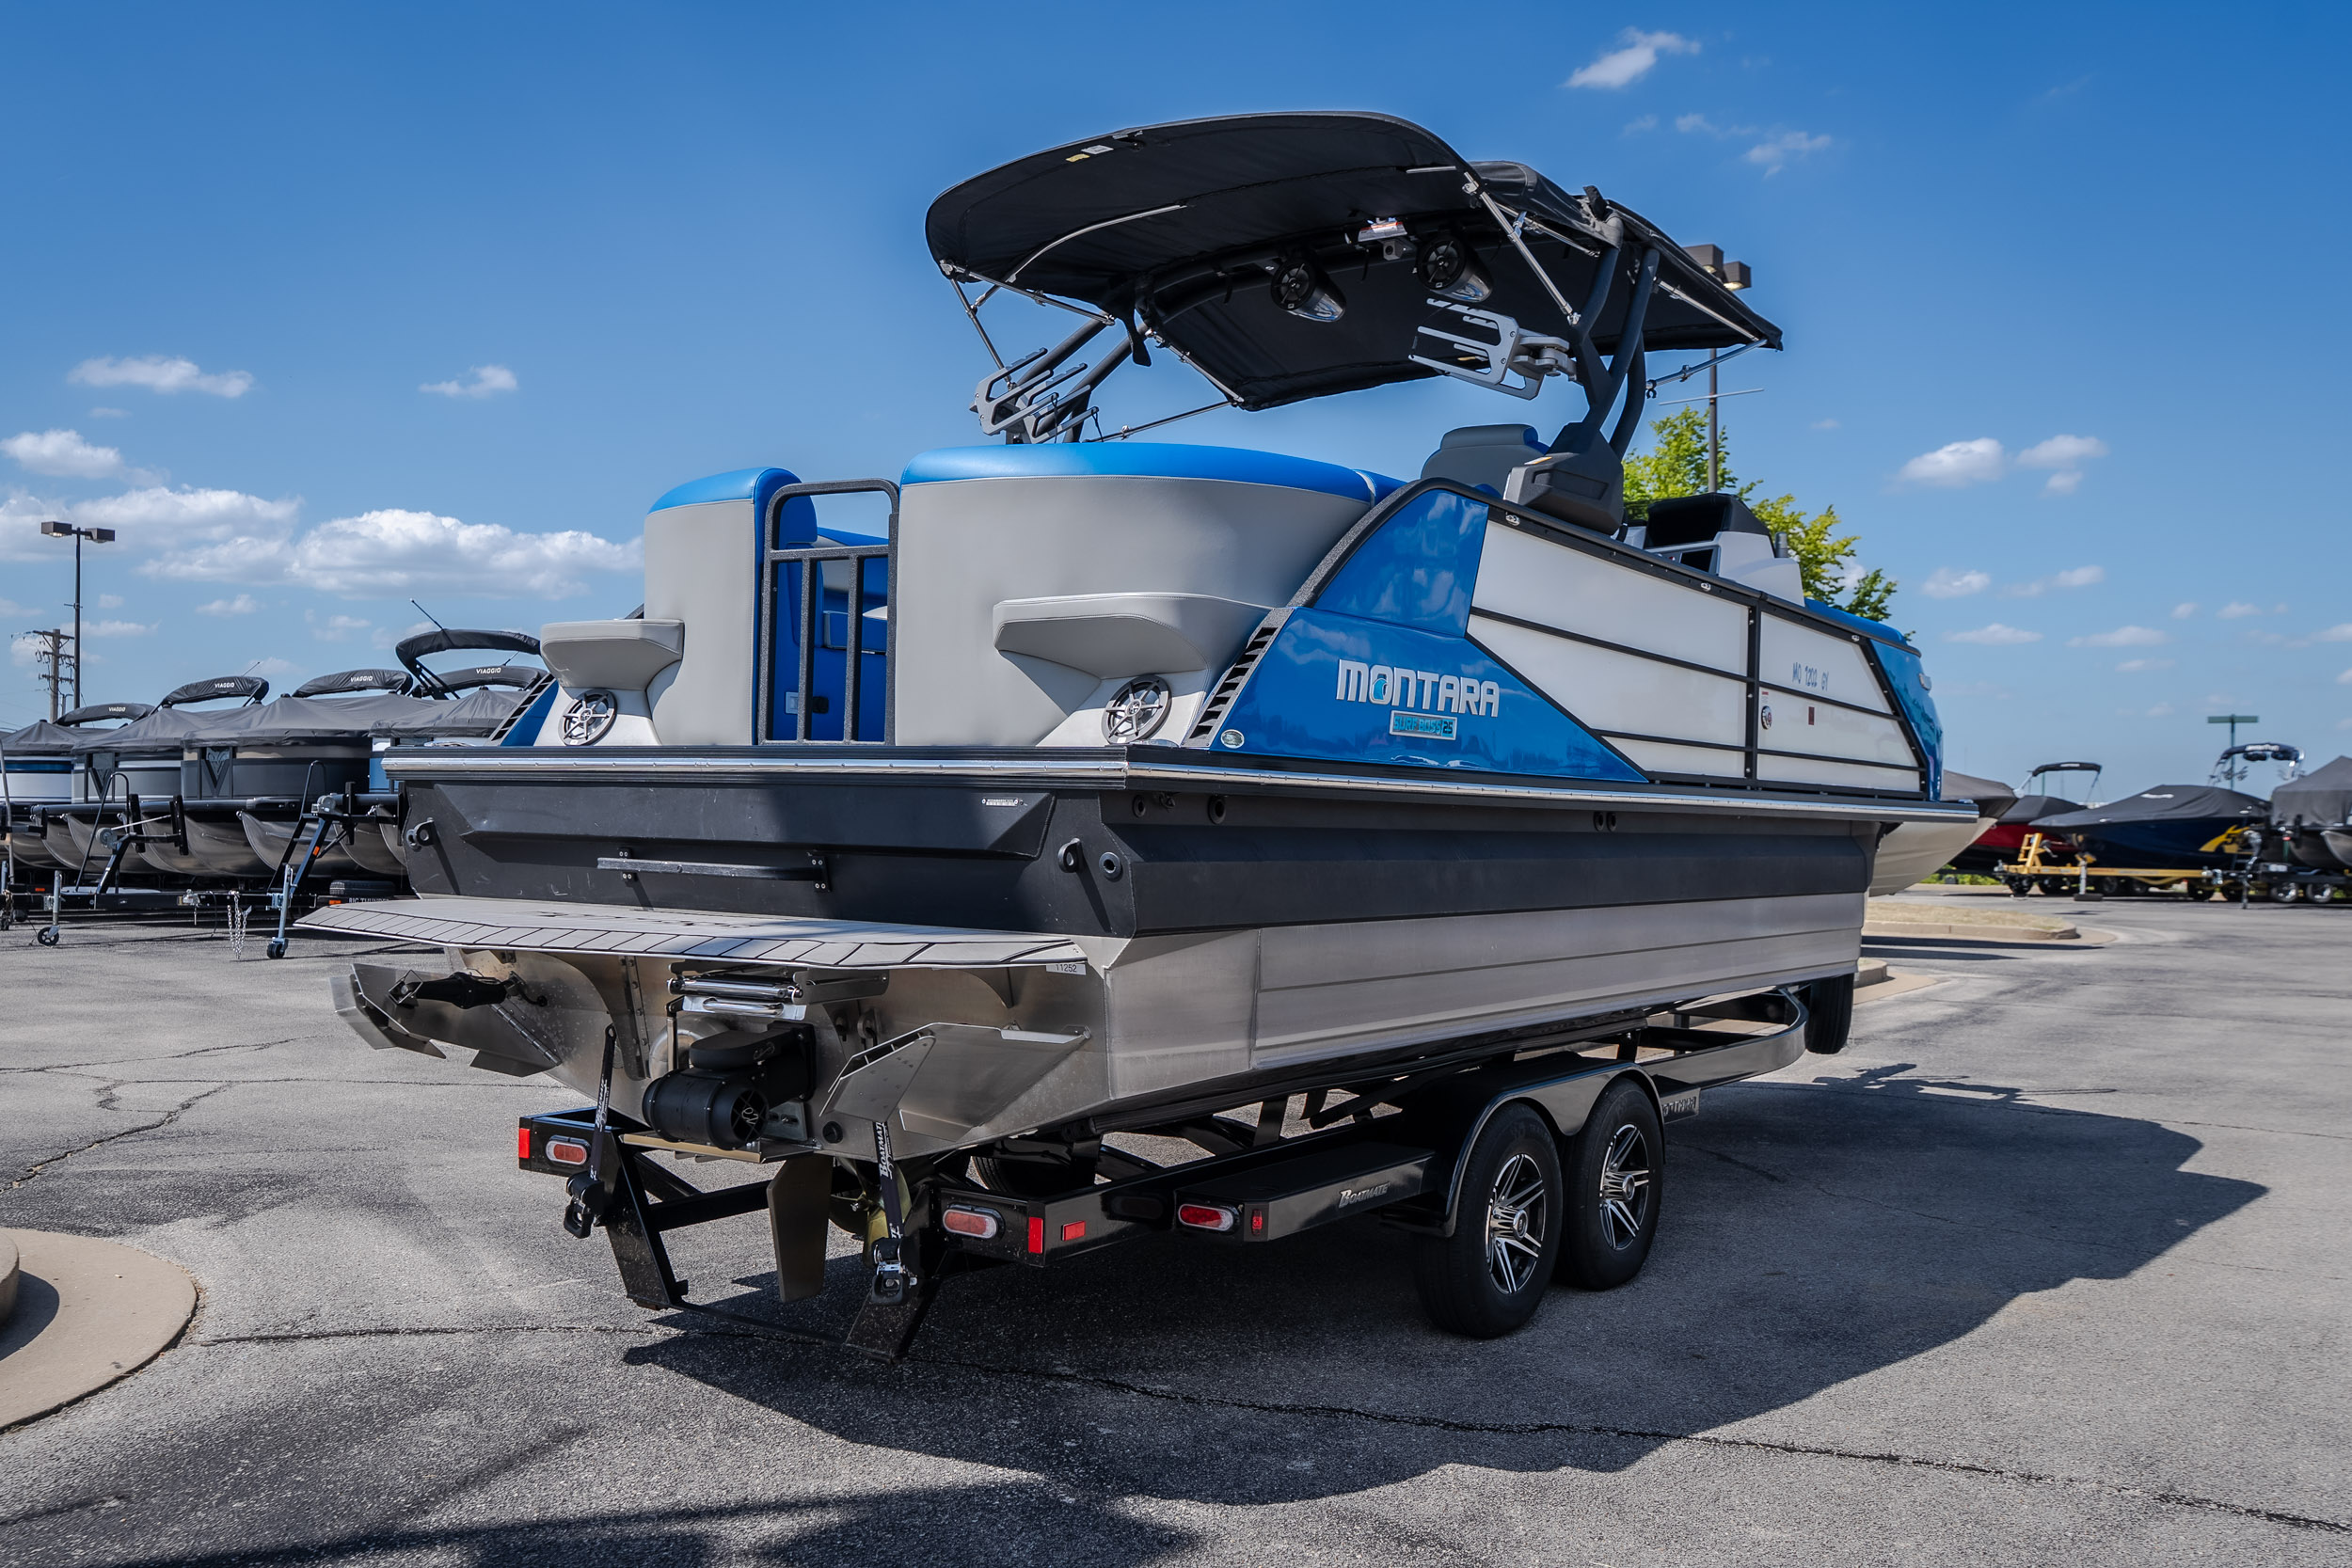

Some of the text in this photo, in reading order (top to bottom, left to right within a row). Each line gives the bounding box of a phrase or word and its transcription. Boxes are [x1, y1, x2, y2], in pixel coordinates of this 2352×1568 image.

[1792, 662, 1802, 684] MO
[1336, 658, 1500, 718] MONTARA
[1393, 716, 1454, 735] SURF BOSS 25
[1056, 964, 1077, 973] 11252
